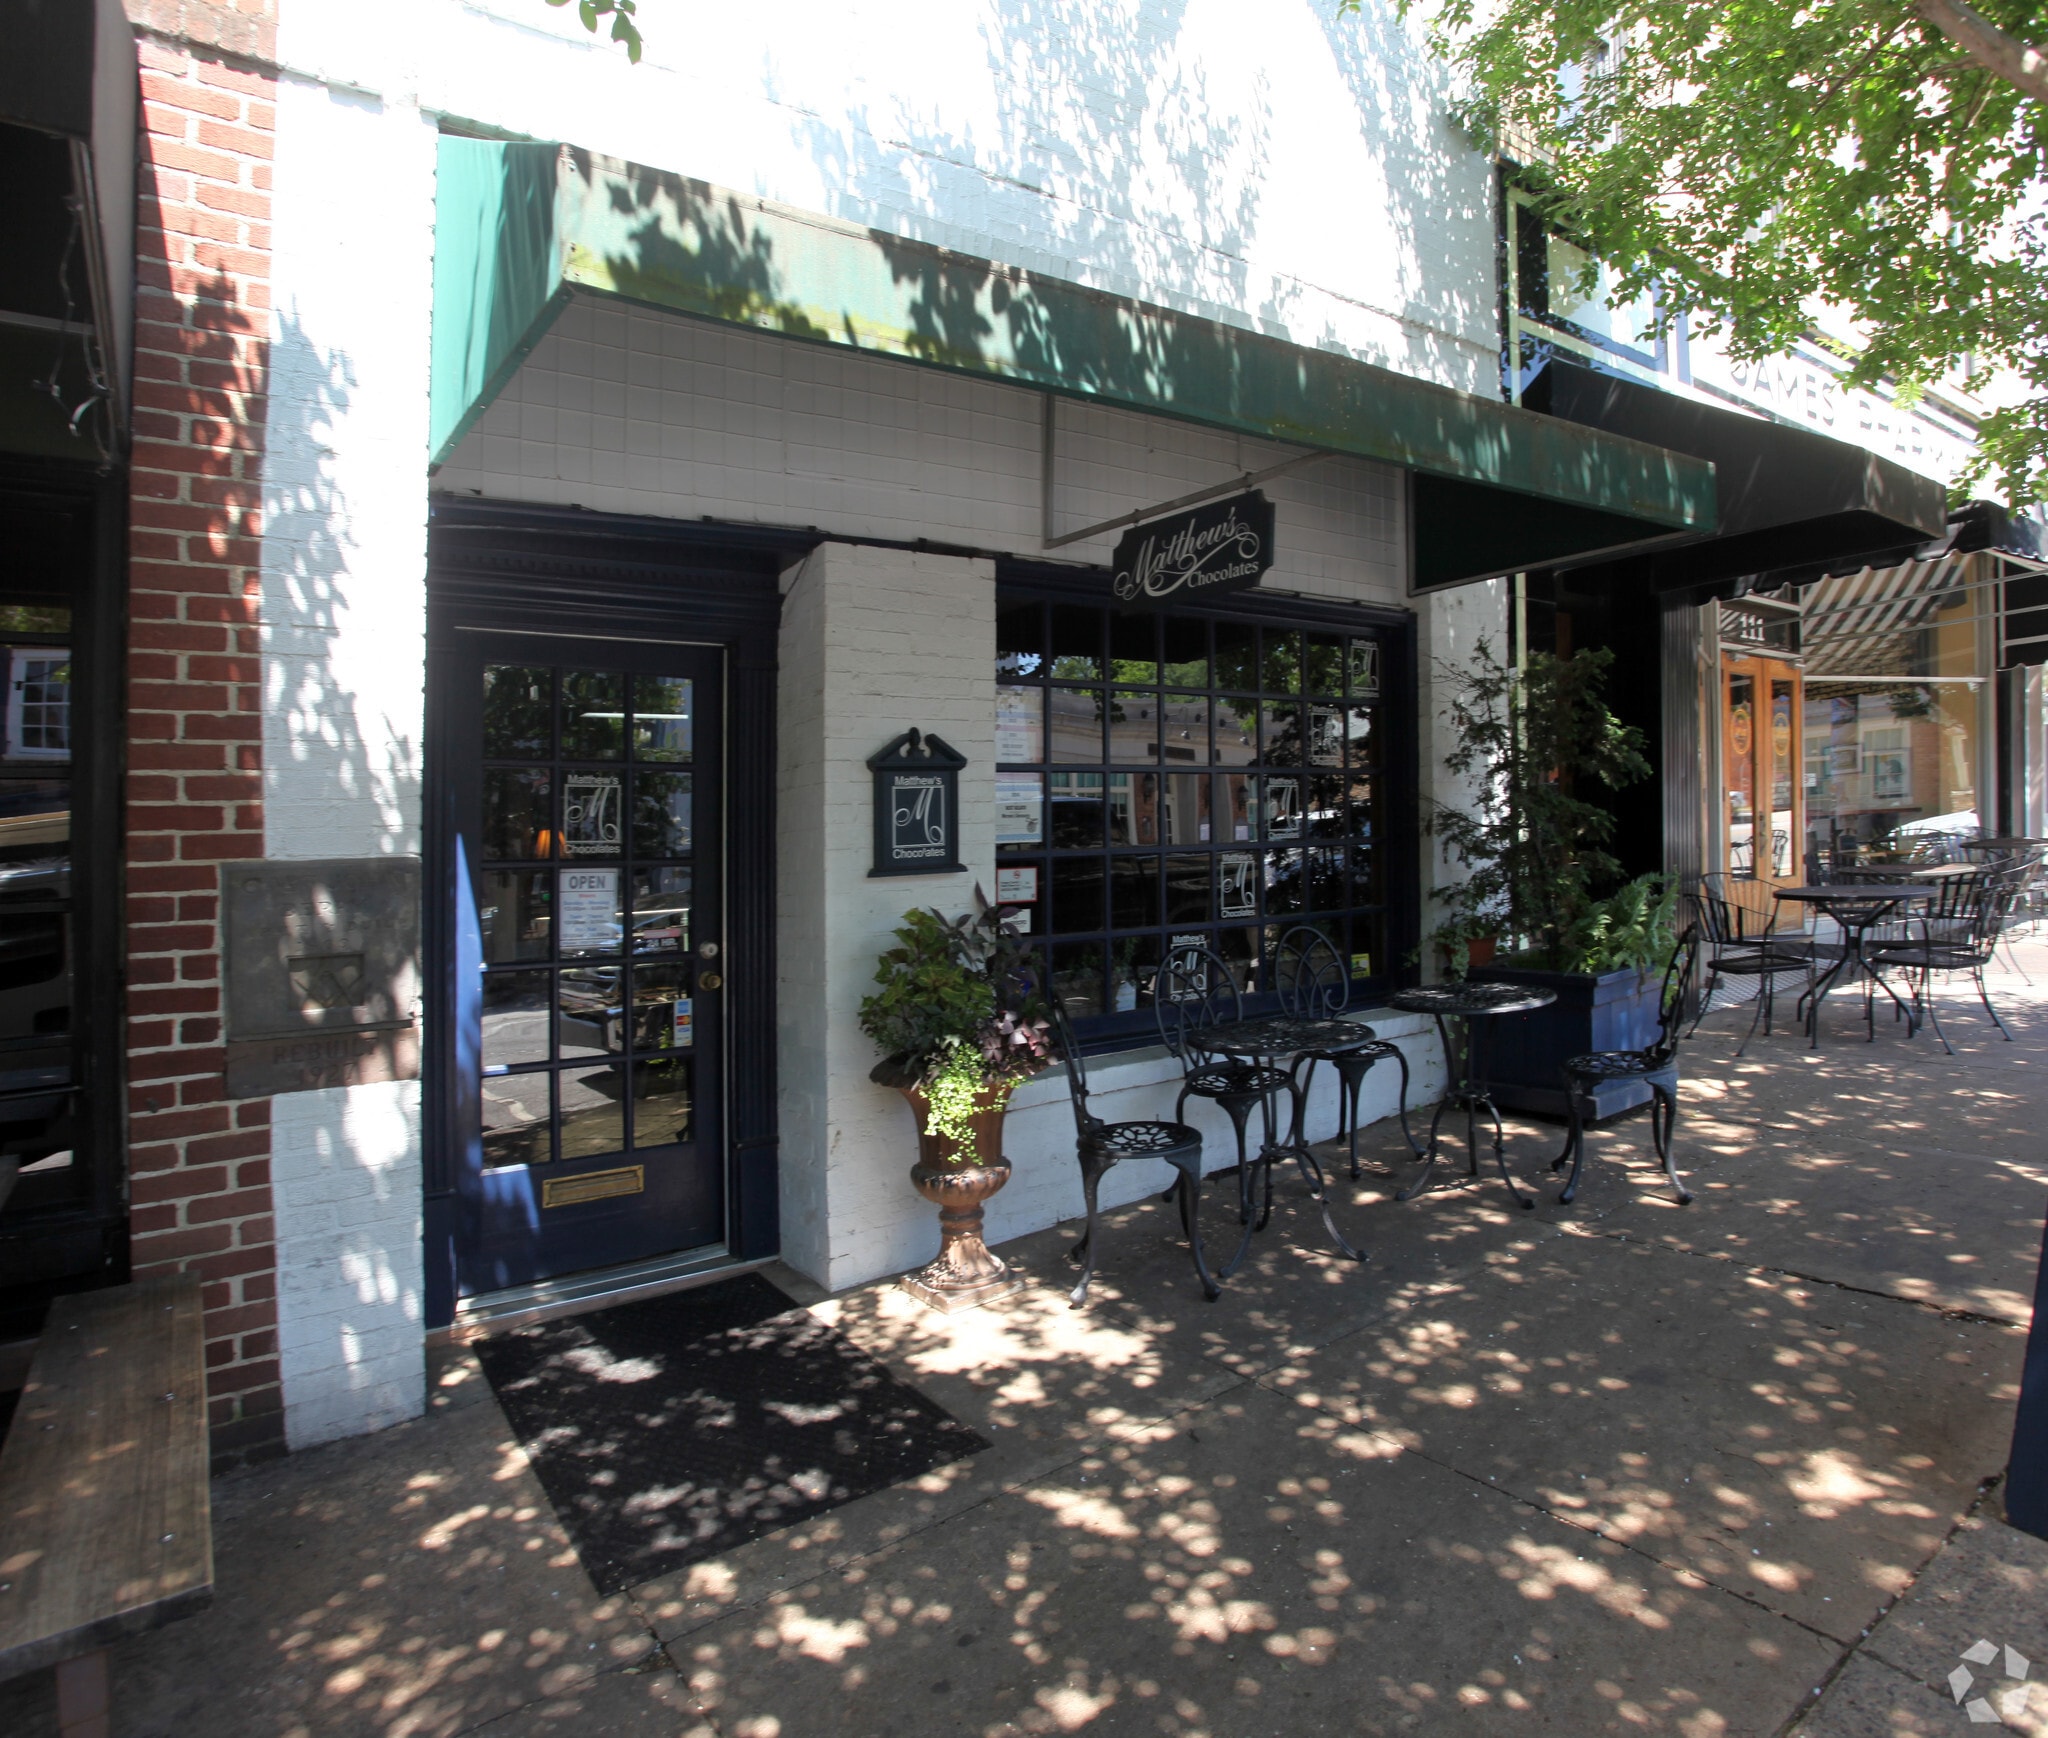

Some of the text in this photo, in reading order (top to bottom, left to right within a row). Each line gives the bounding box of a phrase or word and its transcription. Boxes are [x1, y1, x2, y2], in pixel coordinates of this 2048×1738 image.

[1730, 356, 1834, 427] JAMES
[1114, 506, 1256, 600] Matthew's
[1187, 560, 1260, 588] Chocolates
[1740, 612, 1765, 641] 111
[567, 774, 620, 785] Matthew's
[894, 776, 942, 786] Matthew's
[564, 843, 621, 854] Chocolates
[892, 847, 945, 859] Chocolates
[568, 875, 606, 890] OPEN
